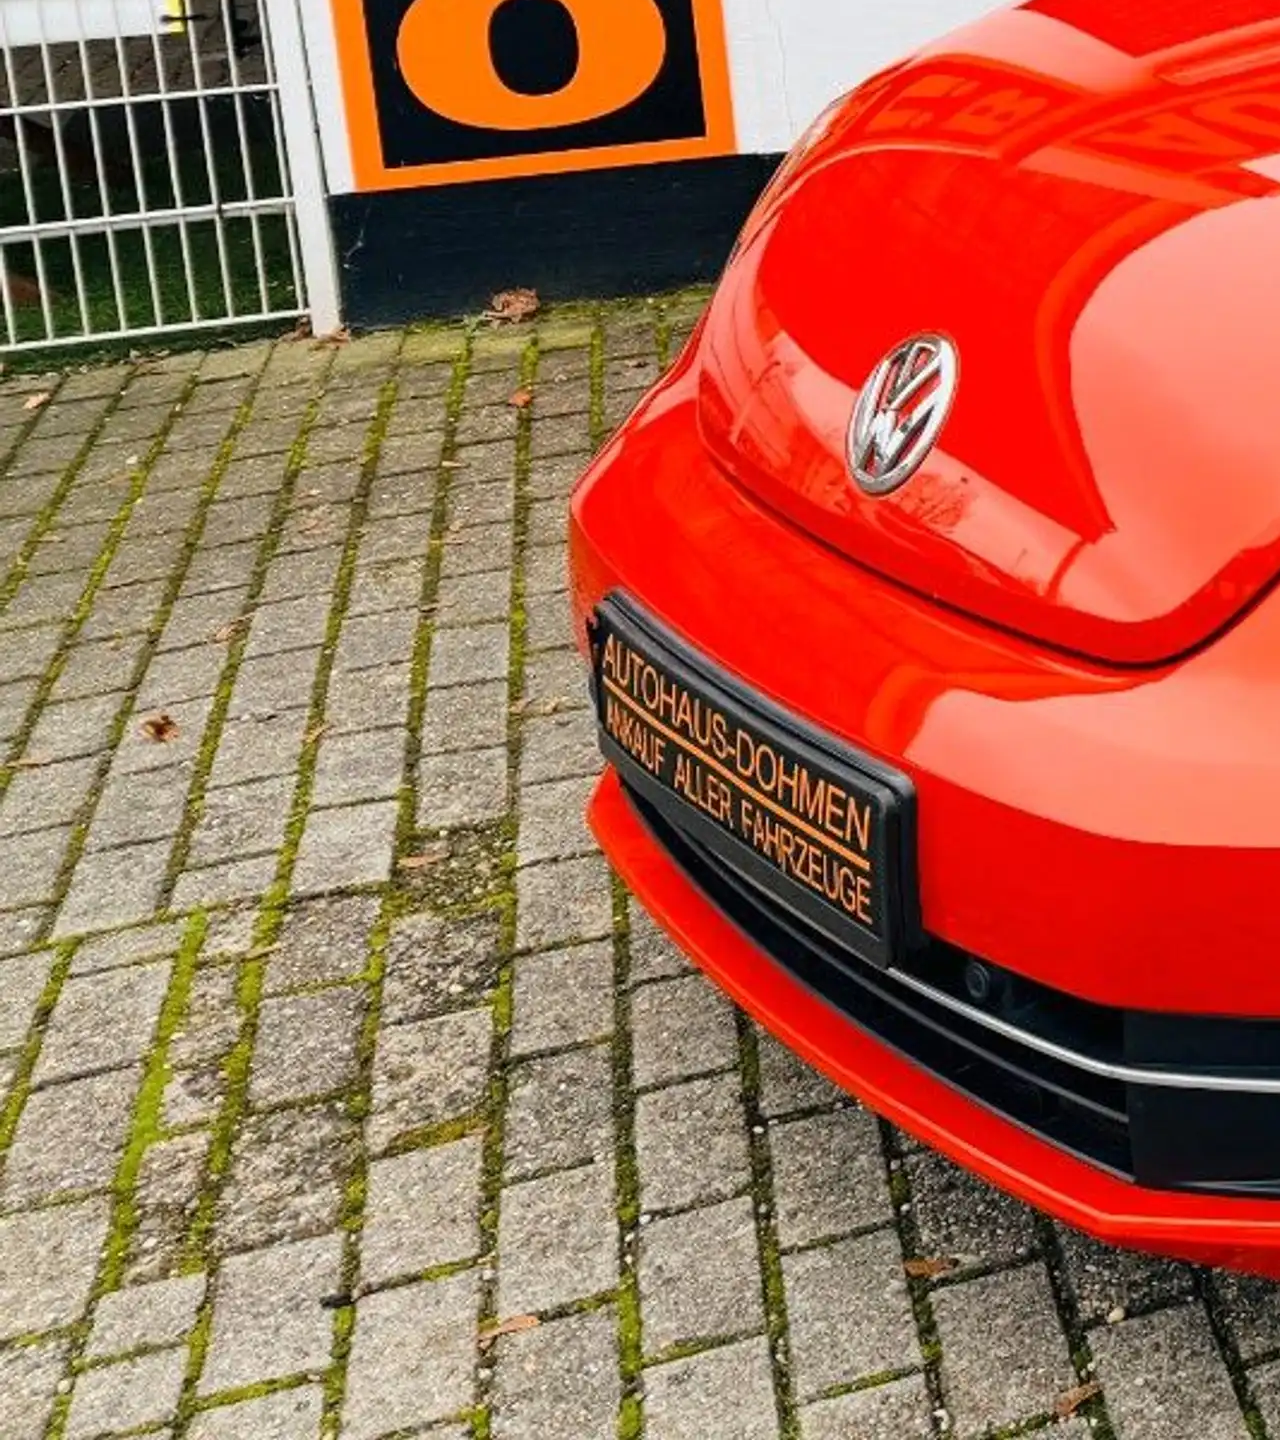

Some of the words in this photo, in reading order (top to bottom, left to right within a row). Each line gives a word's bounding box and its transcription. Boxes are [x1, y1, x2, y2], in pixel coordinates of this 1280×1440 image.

[602, 632, 872, 852] AUTOHAUS-DOHMEN
[606, 697, 666, 776] ANKAUF
[674, 751, 733, 829] ALLER
[740, 799, 873, 925] FAHRZEUGE
